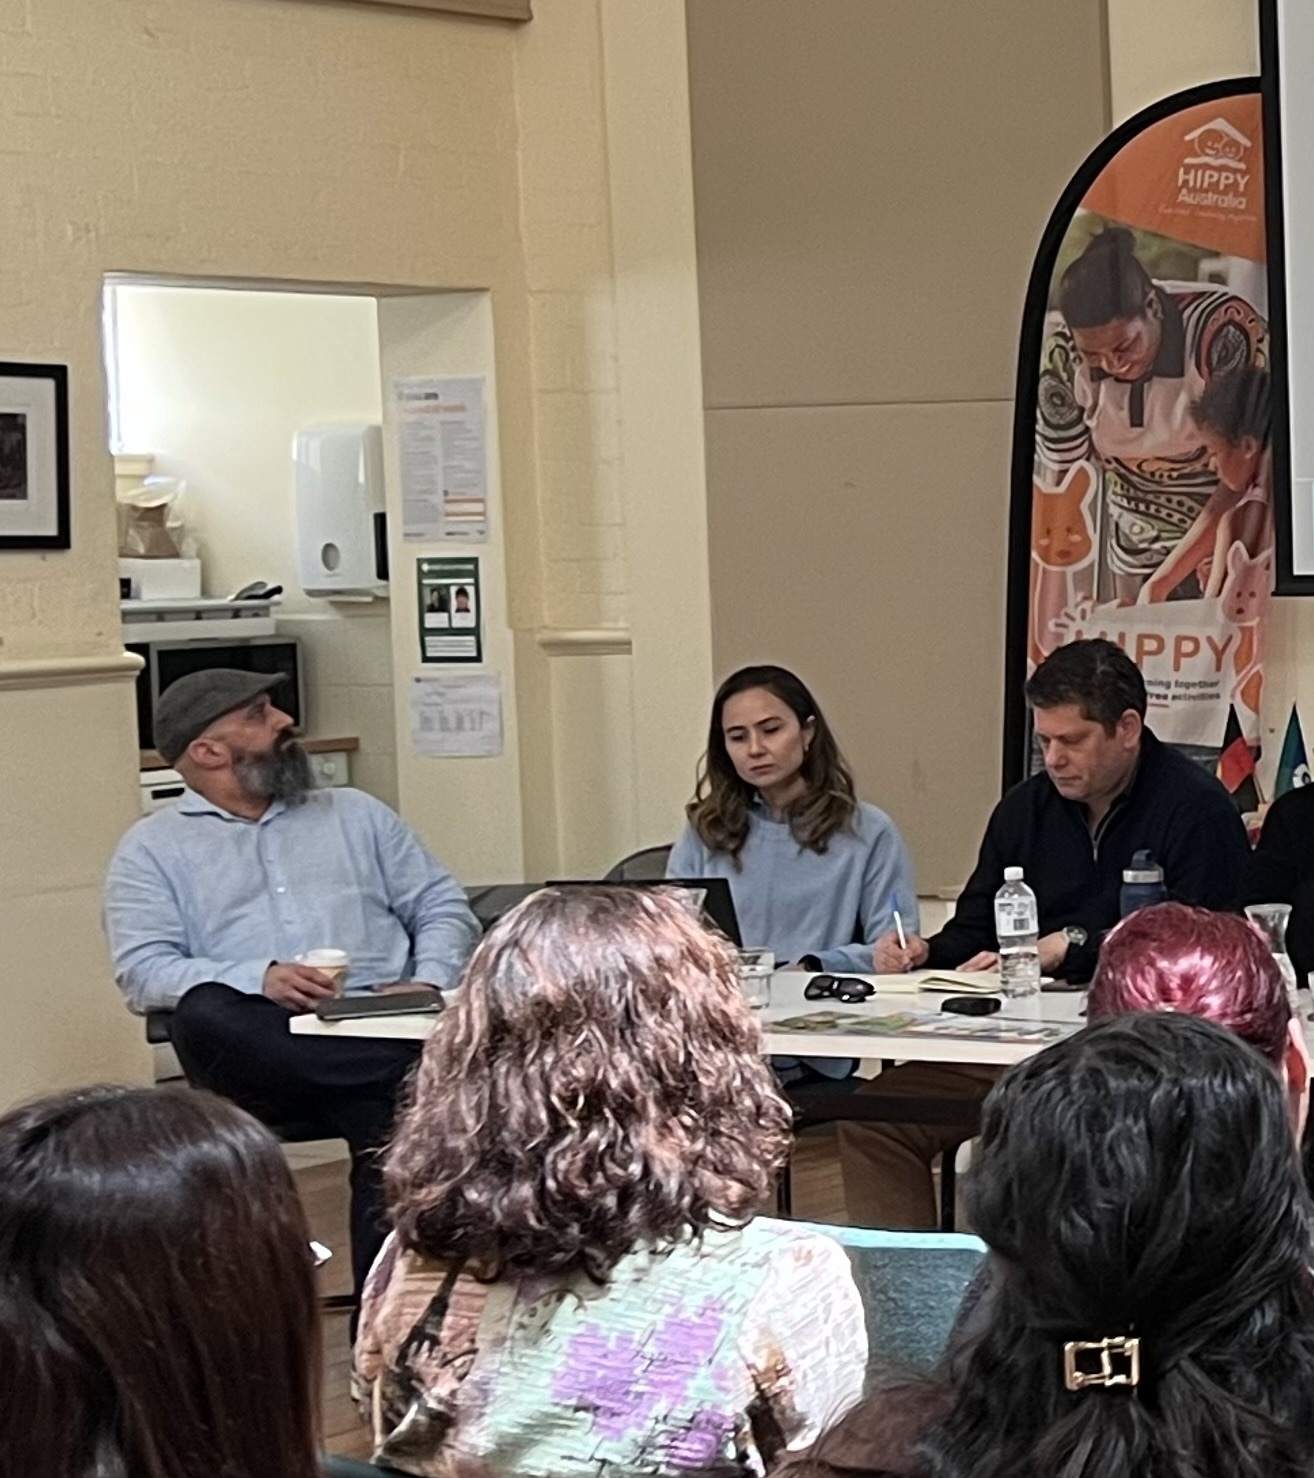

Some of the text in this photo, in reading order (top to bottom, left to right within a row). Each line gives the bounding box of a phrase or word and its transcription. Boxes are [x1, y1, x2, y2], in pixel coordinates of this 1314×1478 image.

[1177, 167, 1250, 192] HIPPY
[1176, 187, 1247, 210] Australia
[1075, 629, 1233, 672] PPY
[1174, 678, 1220, 690] together
[1171, 692, 1221, 702] activities
